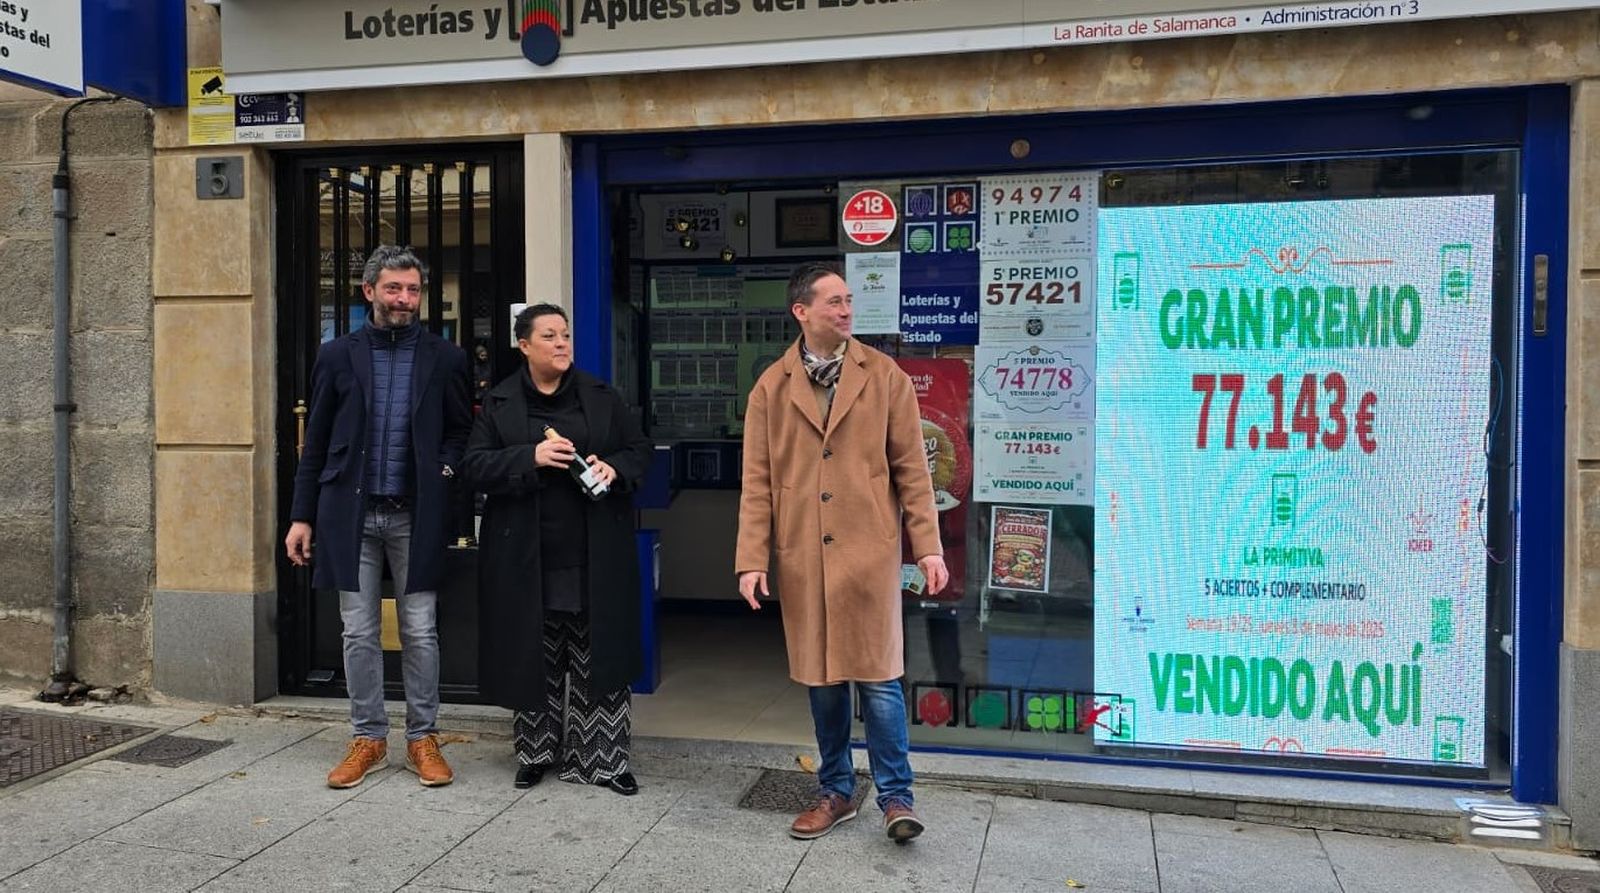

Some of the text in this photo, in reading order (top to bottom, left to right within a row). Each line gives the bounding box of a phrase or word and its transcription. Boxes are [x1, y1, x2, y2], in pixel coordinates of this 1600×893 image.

[21, 7, 28, 22] y
[345, 0, 740, 40] Loterías y Apuestas
[1055, 26, 1071, 41] La
[1075, 23, 1122, 40] Ranita
[1128, 20, 1148, 36] de
[1153, 16, 1236, 34] Salamanca
[1261, 2, 1384, 25] Administración
[30, 29, 50, 48] del
[1, 46, 9, 57] o
[211, 161, 229, 196] 5
[992, 184, 1082, 206] 94974
[853, 196, 884, 214] +18
[665, 217, 720, 233] 5421
[1009, 208, 1079, 225] PREMIO
[1009, 266, 1078, 280] PREMIO
[902, 293, 961, 308] Loterías y
[986, 281, 1081, 305] 57421
[902, 313, 956, 327] Apuestas
[960, 311, 978, 324] del
[1159, 284, 1422, 350] GRAN PREMIO
[902, 331, 941, 342] Estado
[1020, 357, 1055, 365] PREMIO
[996, 368, 1072, 390] 74778
[995, 431, 1073, 441] GRAN PREMIO
[992, 479, 1074, 492] VENDIDO AQUÍ
[1002, 524, 1039, 537] CERRADO
[1243, 546, 1325, 567] LA PRIMITIVA
[1204, 578, 1211, 595] 5
[1212, 579, 1260, 597] ACIERTOS
[1270, 580, 1366, 600] COMPLEMENTARIO
[1148, 642, 1424, 737] VENDIDO AQUÍ
